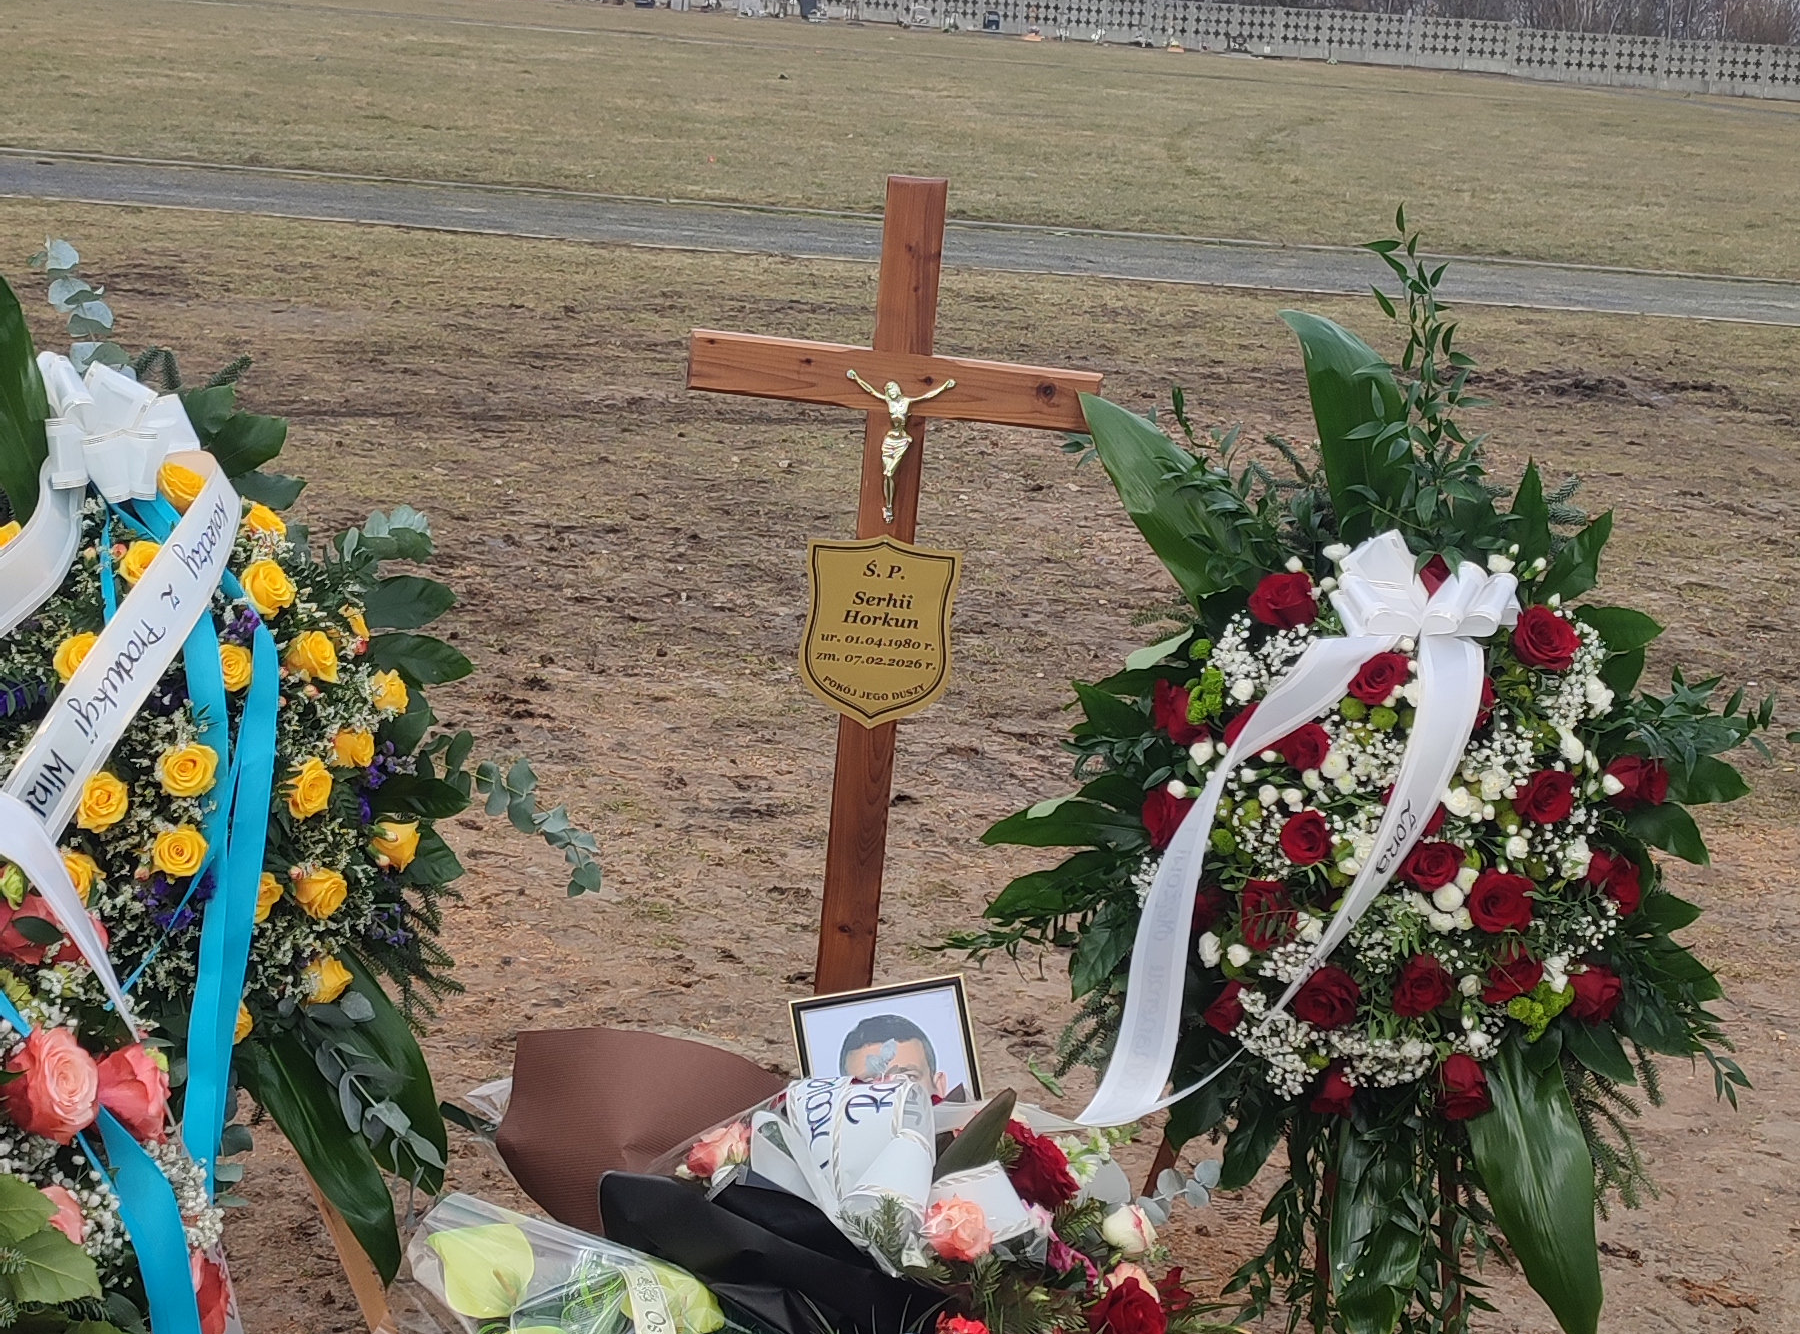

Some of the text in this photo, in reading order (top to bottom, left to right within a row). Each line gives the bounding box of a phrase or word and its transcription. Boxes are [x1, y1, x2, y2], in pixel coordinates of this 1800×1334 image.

[863, 559, 905, 580] Ś. P.
[852, 591, 914, 610] Serhii
[842, 609, 919, 630] Horkun
[820, 633, 936, 651] ur. 01.04.1980 r.
[815, 651, 937, 671] zm. 07.02.2026 r.
[823, 675, 926, 701] POKÓJ JEGO DUSZY
